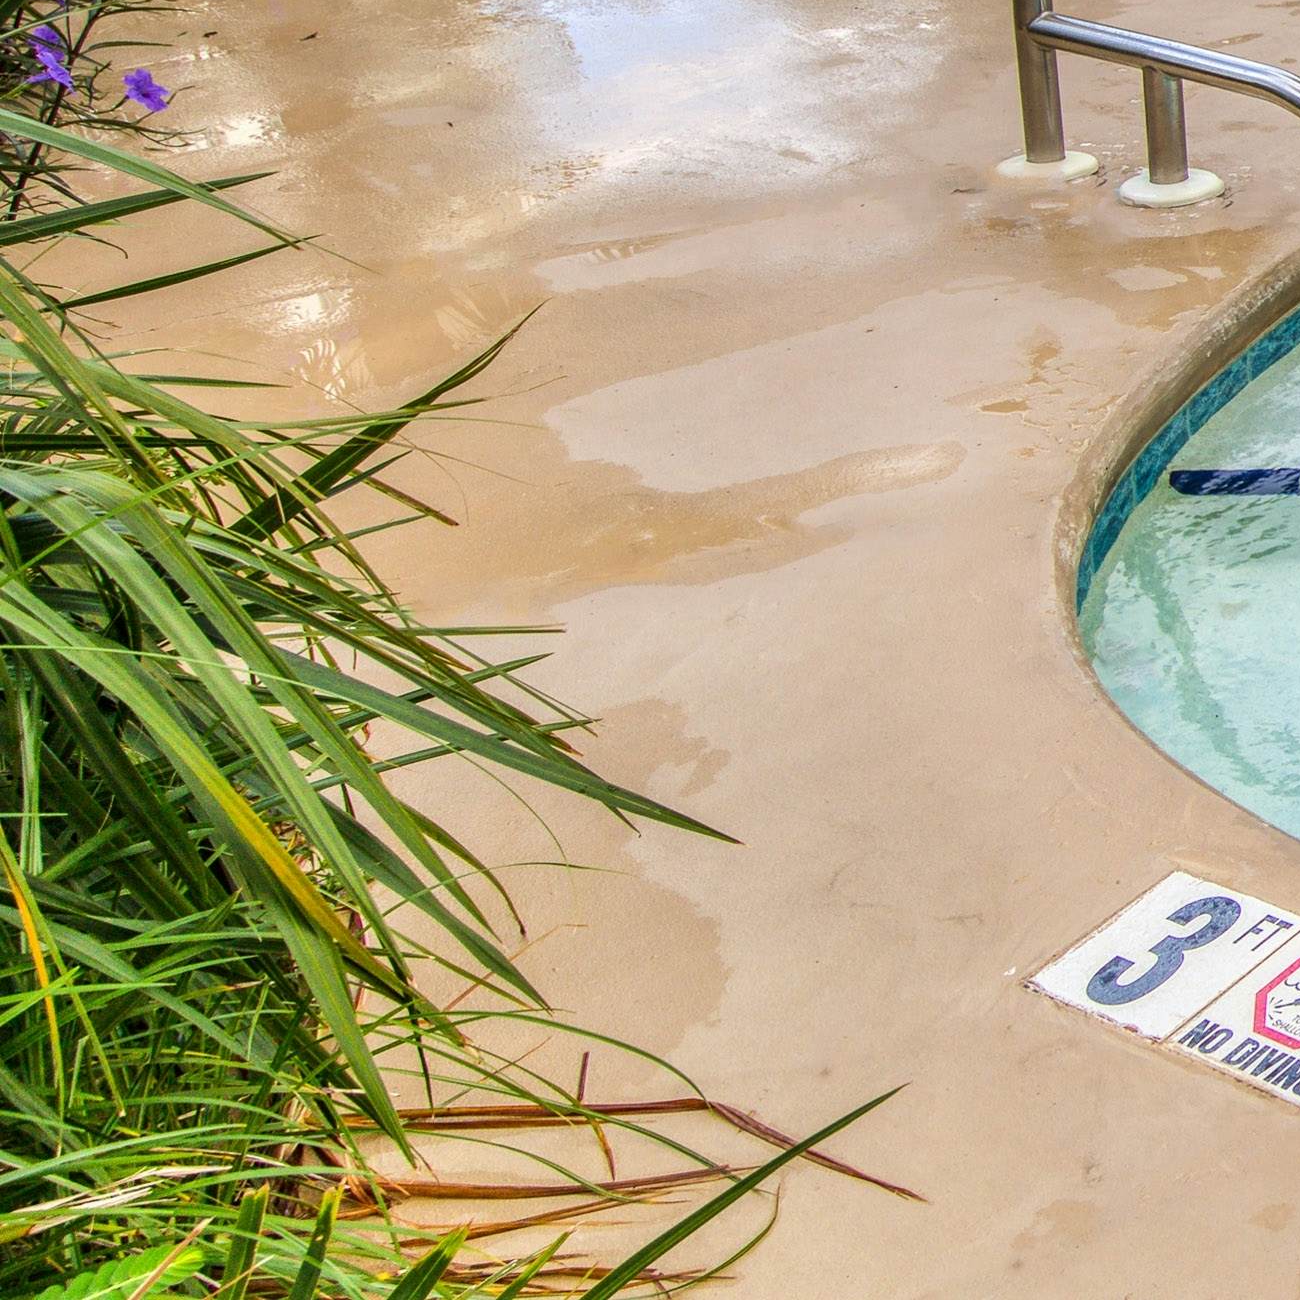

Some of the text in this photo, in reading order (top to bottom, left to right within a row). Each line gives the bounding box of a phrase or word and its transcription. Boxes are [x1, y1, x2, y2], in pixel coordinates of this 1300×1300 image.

[1086, 895, 1294, 1006] 3 FT
[1177, 1018, 1234, 1054] NO
